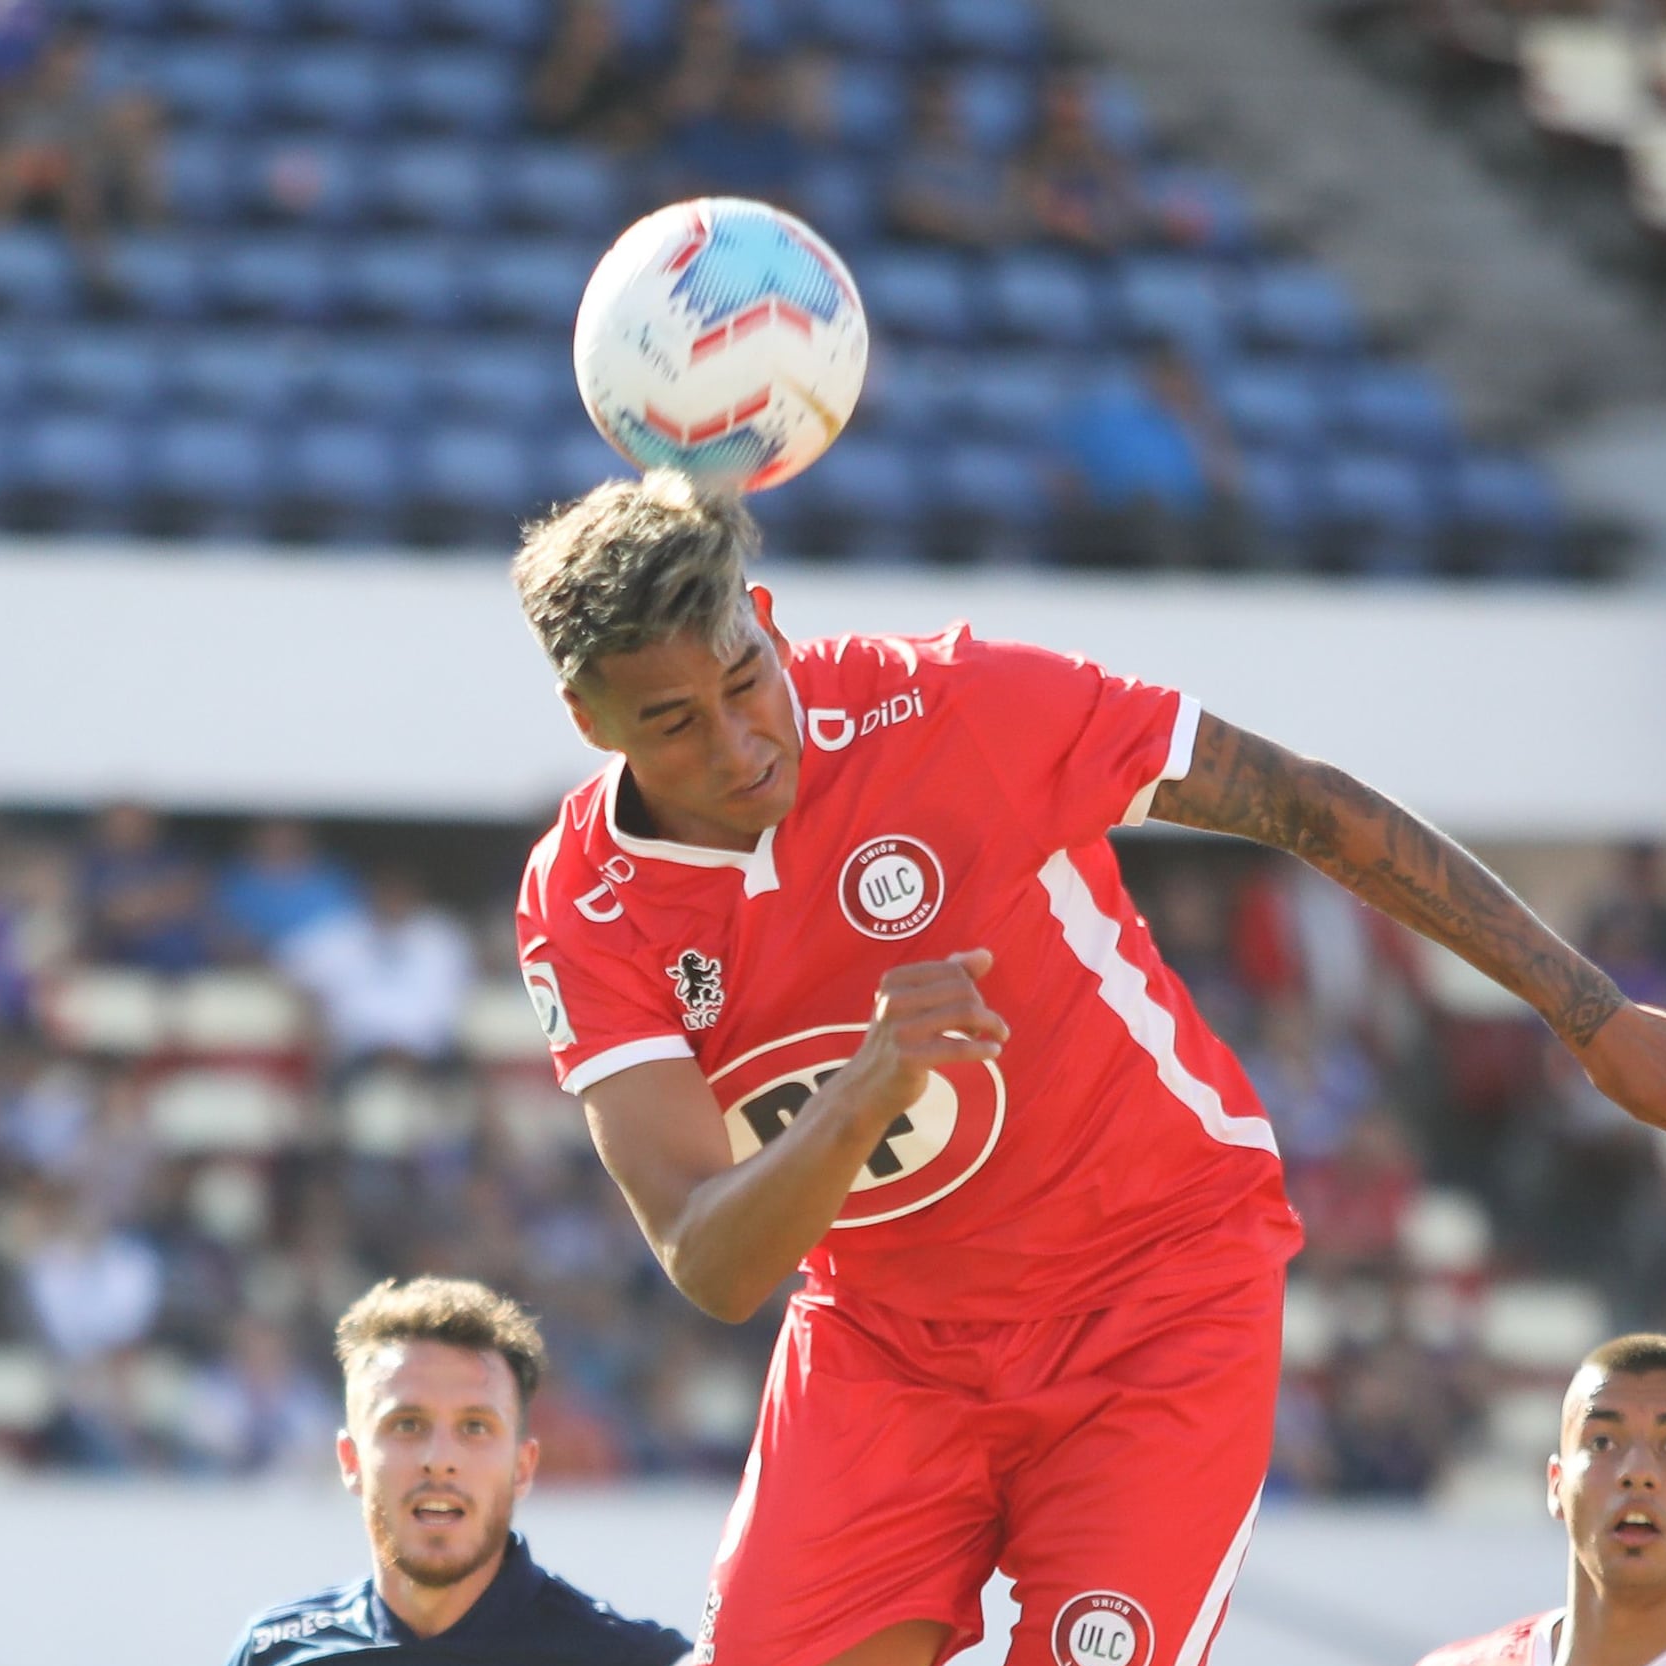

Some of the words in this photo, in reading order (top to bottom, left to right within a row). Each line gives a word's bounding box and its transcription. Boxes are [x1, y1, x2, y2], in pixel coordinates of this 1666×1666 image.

[860, 689, 925, 737] DiDi
[865, 866, 916, 909] ULC
[683, 1011, 720, 1031] LYO
[1077, 1622, 1127, 1661] ULC
